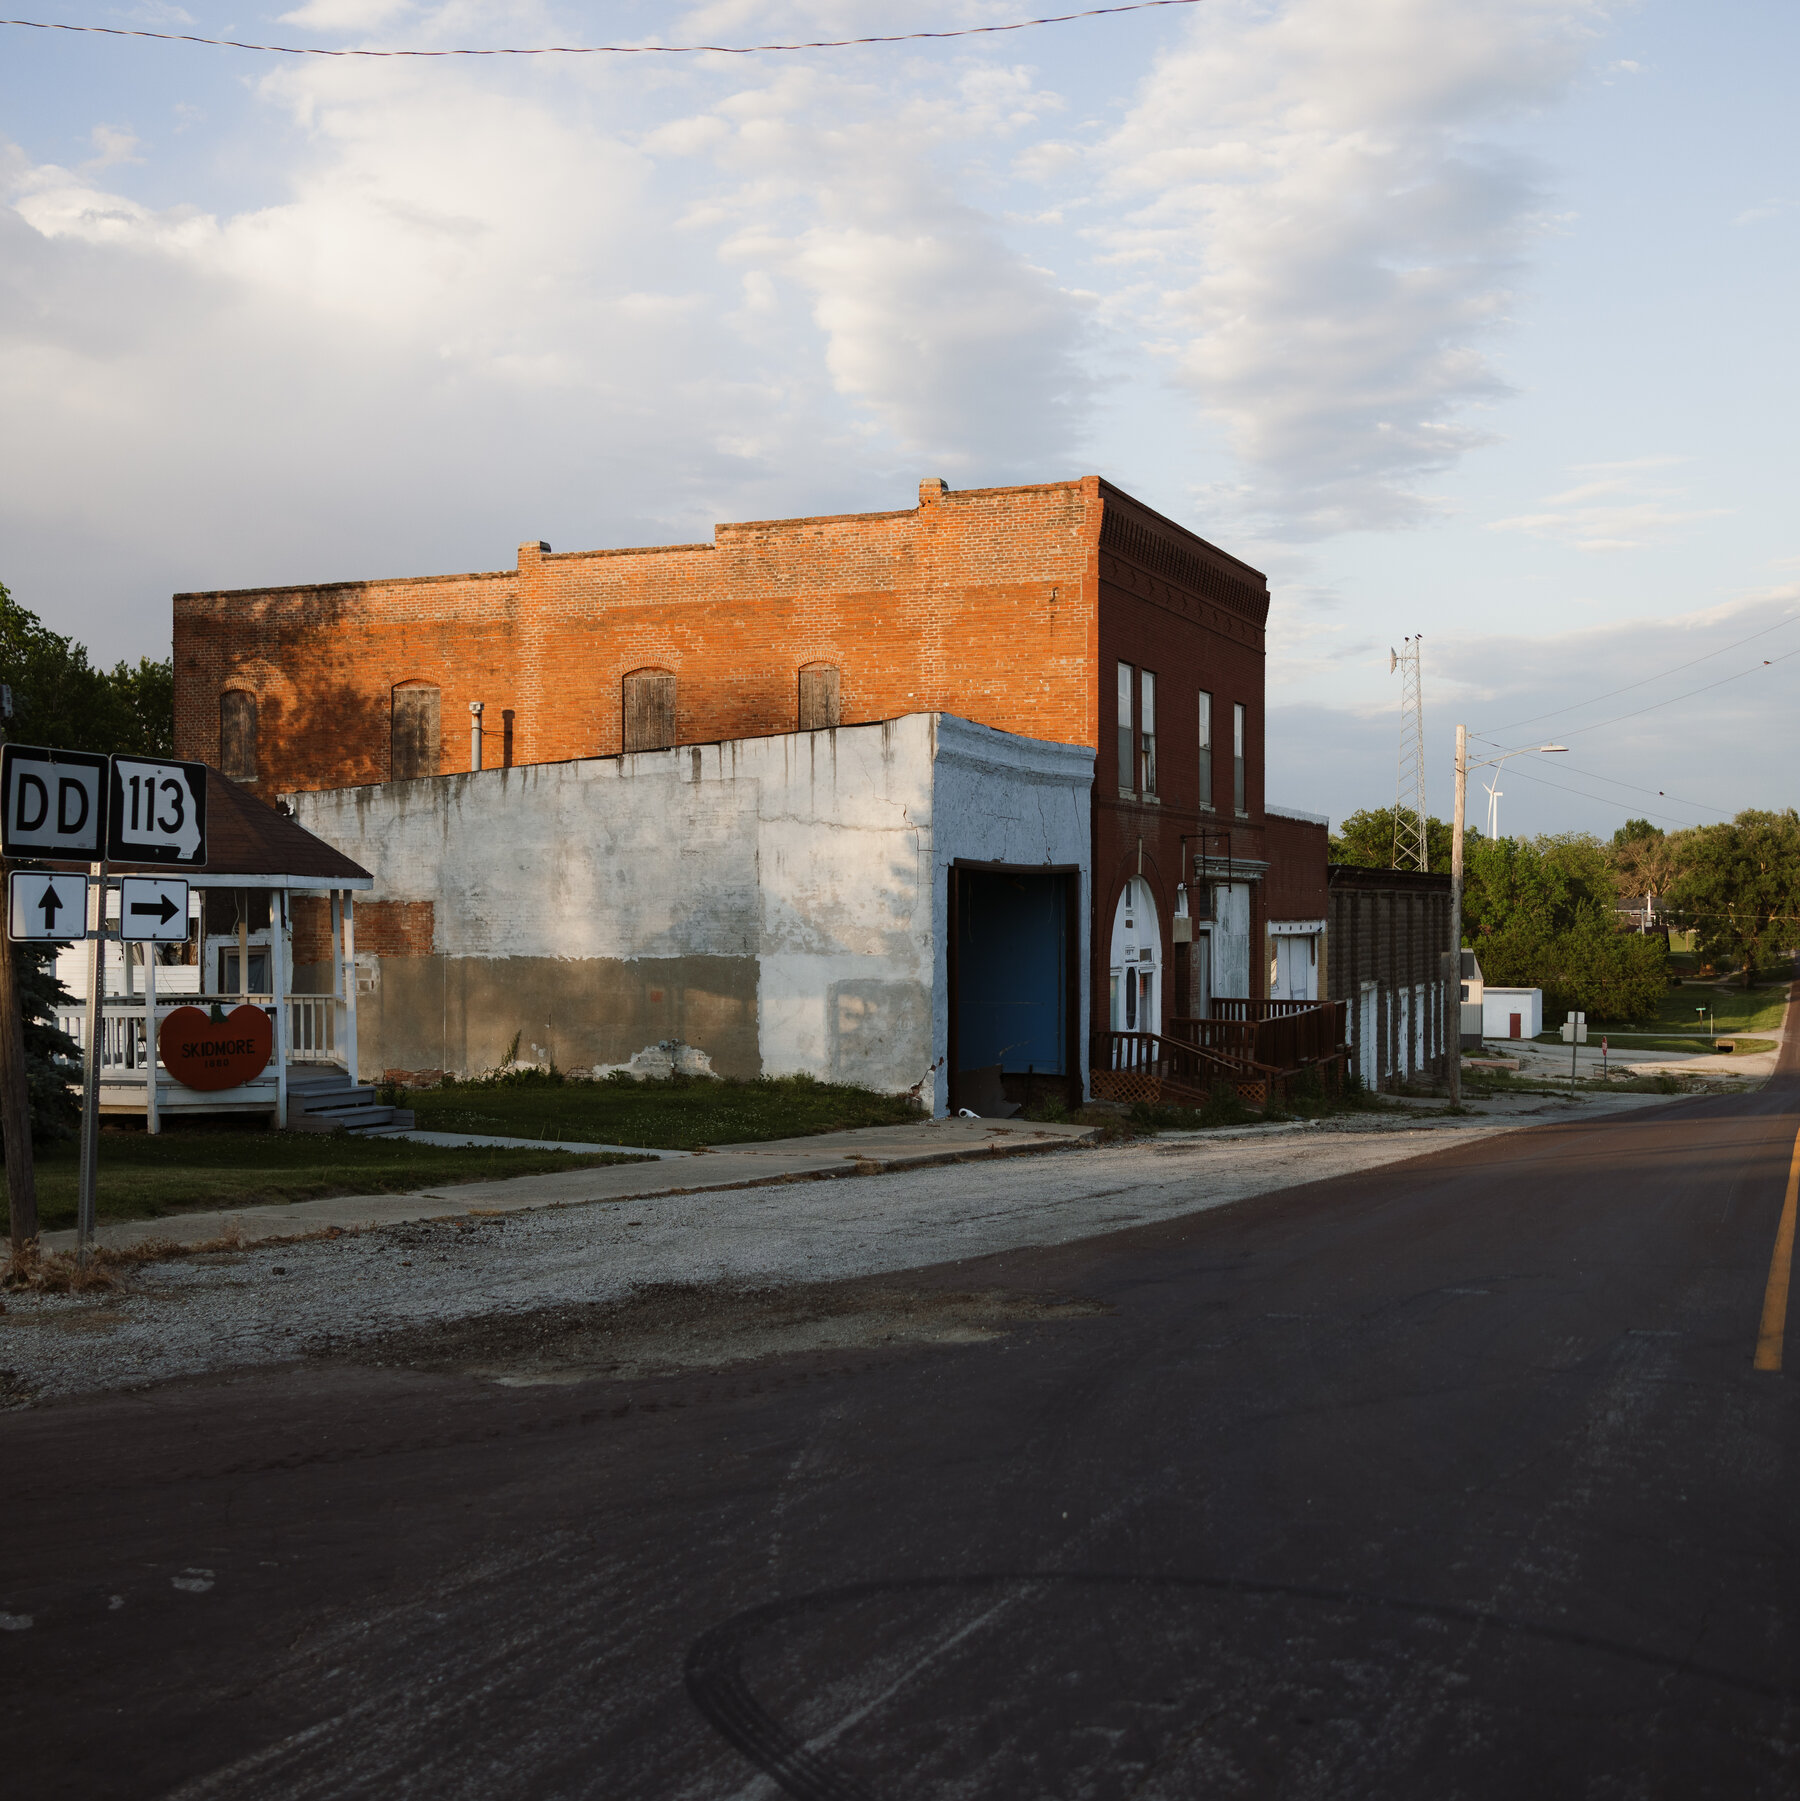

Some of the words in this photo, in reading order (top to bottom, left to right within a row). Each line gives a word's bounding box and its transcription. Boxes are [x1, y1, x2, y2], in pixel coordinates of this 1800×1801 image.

[16, 773, 89, 834] DD
[129, 775, 185, 834] 113
[182, 1039, 256, 1058] SKIDMORE
